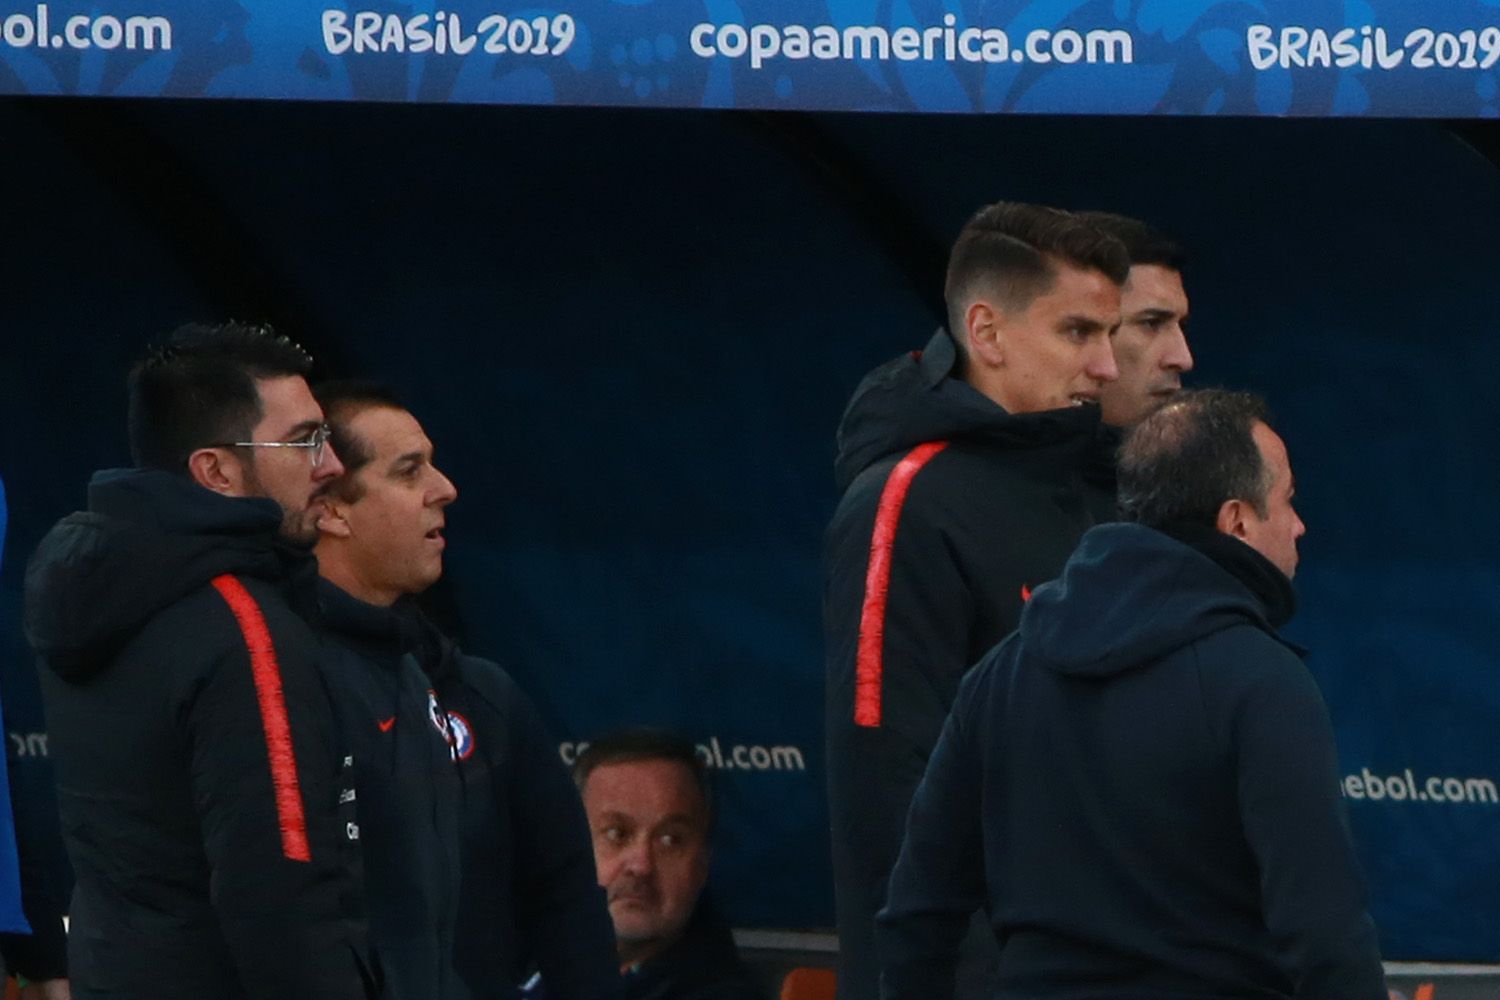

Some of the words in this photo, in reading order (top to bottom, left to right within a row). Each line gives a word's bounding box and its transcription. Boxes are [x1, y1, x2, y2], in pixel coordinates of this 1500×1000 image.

[0, 4, 171, 50] ol.com
[477, 14, 575, 56] 2019
[690, 14, 1133, 69] copaamerica.com
[1341, 767, 1499, 803] ebol.com
